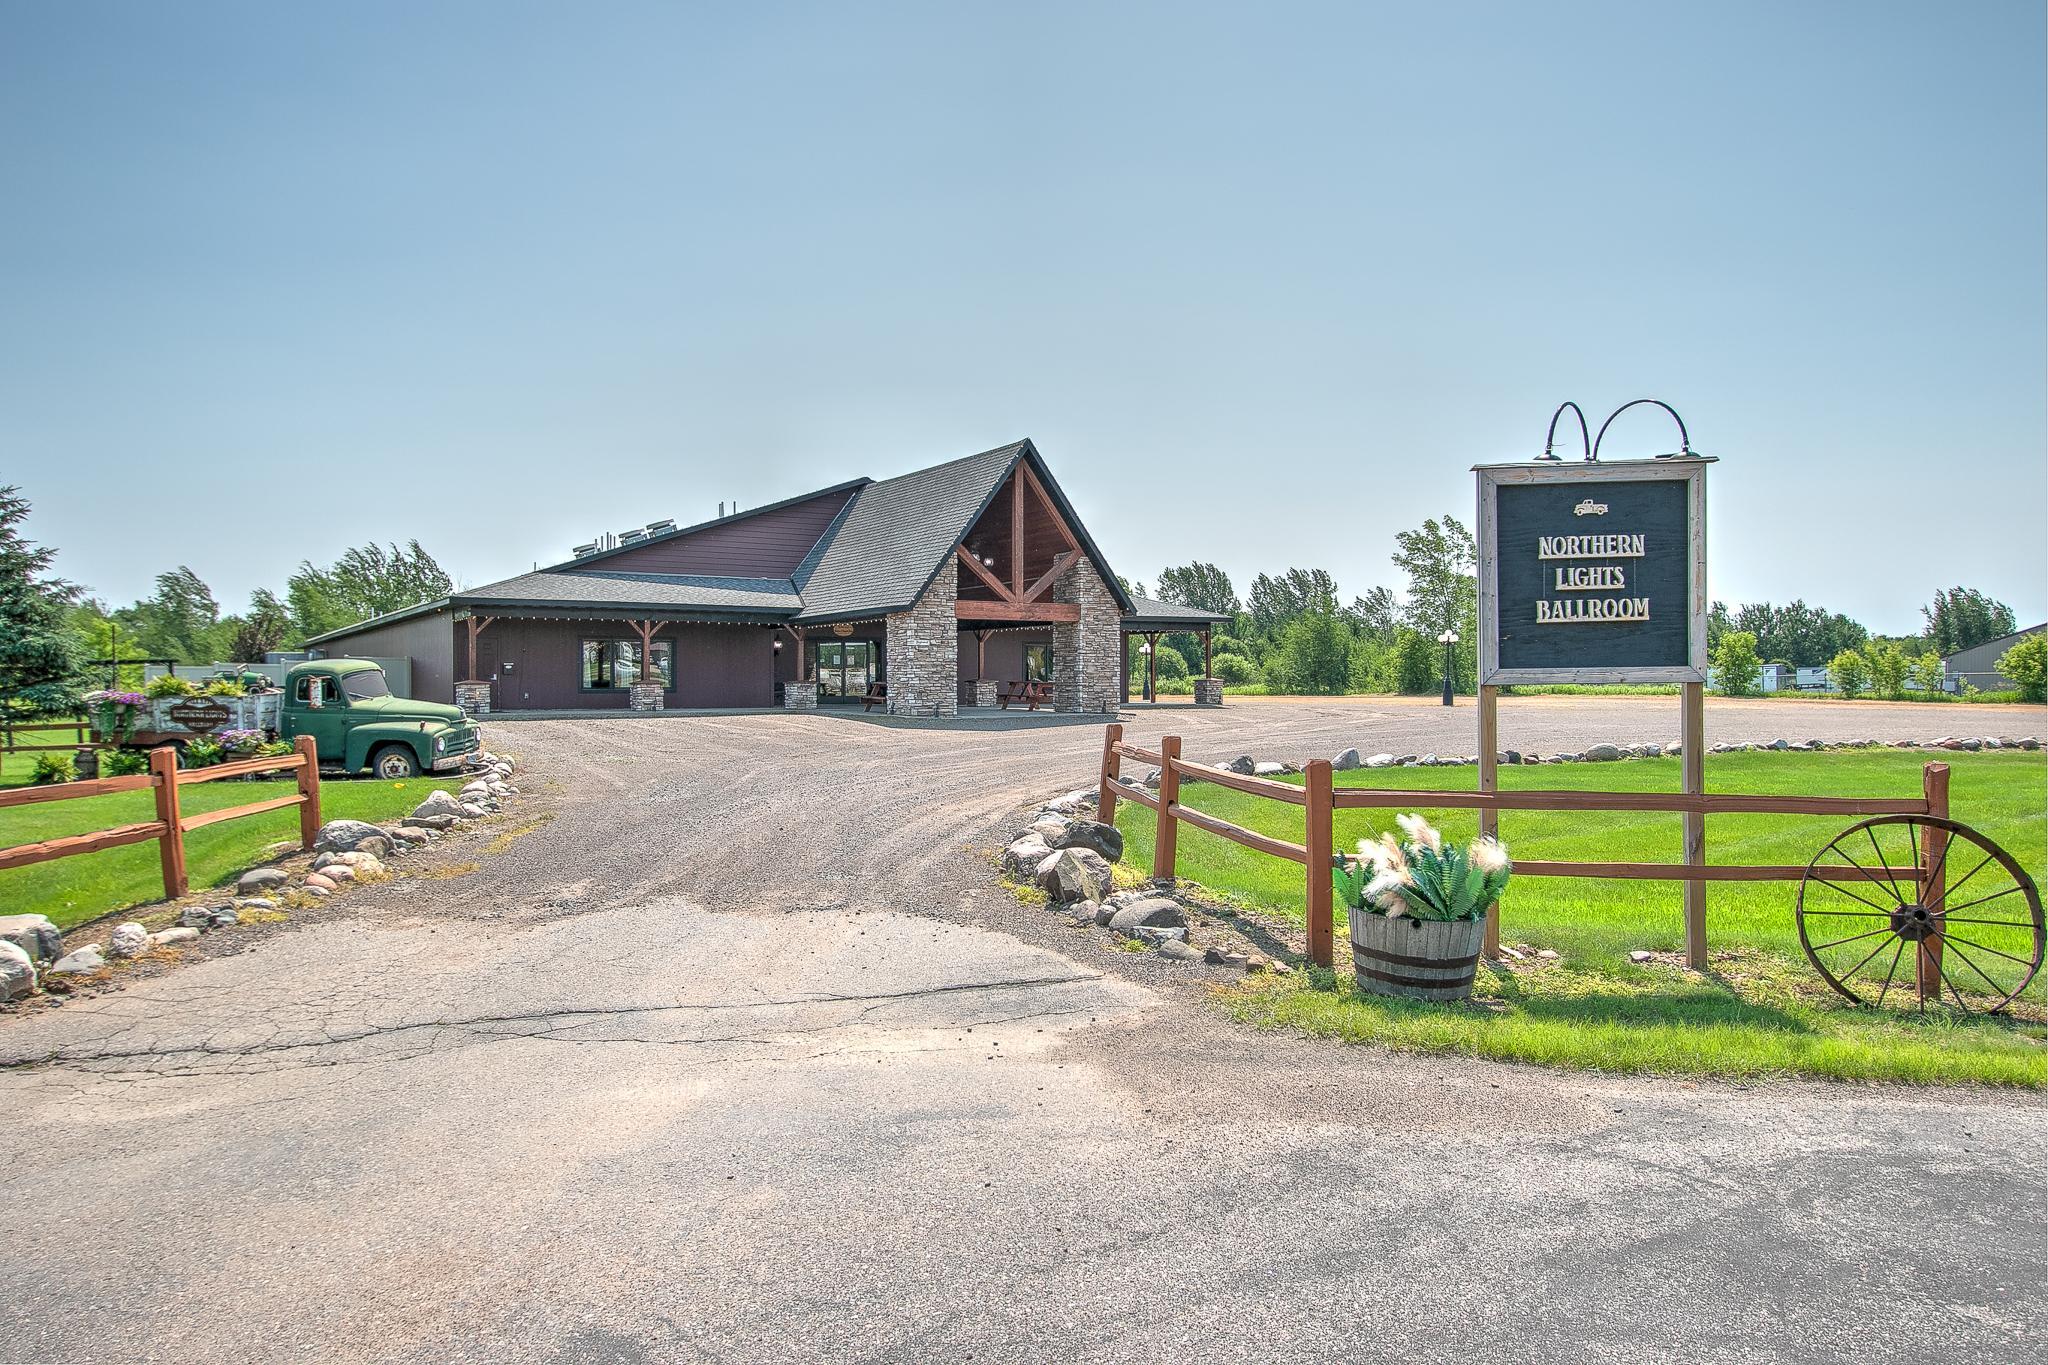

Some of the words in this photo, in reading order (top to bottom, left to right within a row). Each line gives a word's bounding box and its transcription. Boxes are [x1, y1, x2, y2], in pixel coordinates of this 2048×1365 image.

[1539, 534, 1645, 559] NORTHERN
[1555, 566, 1625, 590] LIGHTS
[1536, 598, 1649, 623] BALLROOM
